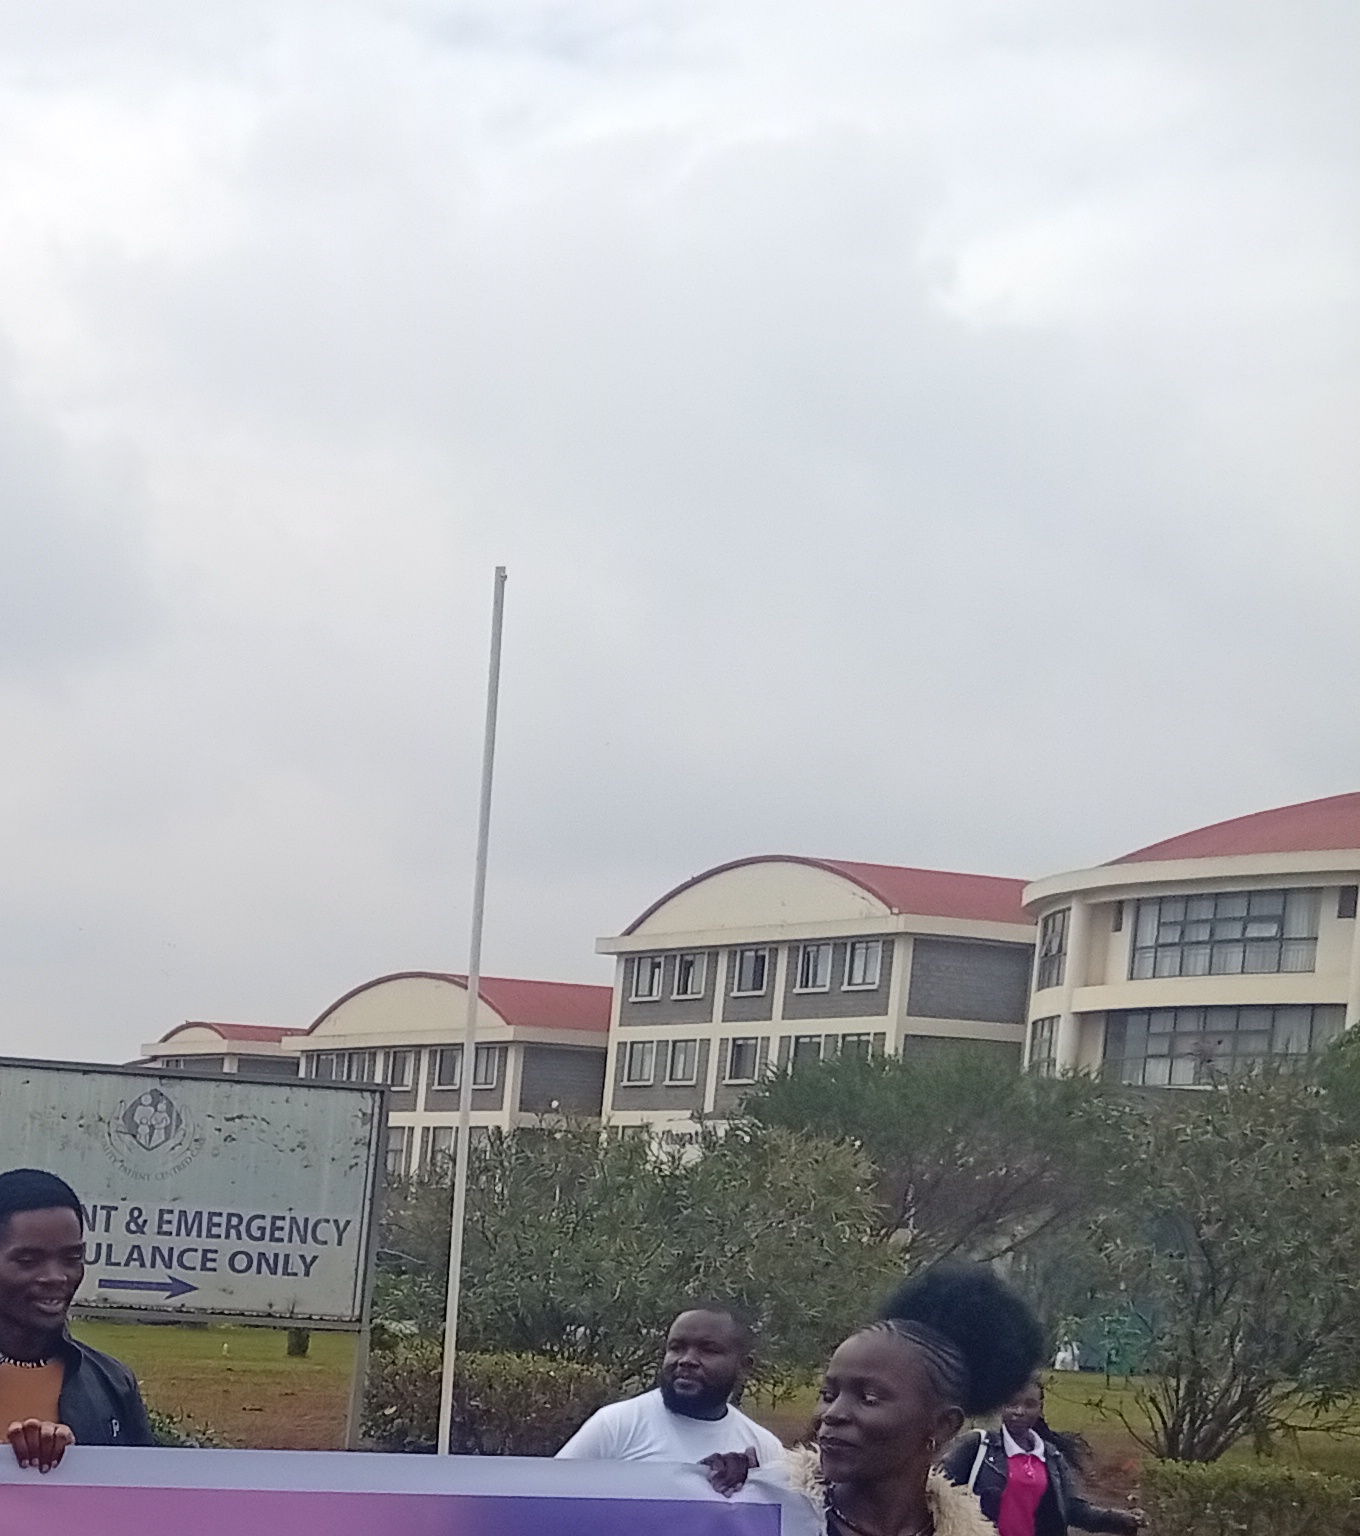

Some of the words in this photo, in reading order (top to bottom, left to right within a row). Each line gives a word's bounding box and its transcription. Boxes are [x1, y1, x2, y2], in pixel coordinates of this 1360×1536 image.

[125, 1206, 148, 1235] &
[156, 1208, 352, 1247] EMERGENCY
[82, 1242, 217, 1272] ULANCE
[228, 1250, 319, 1277] ONLY
